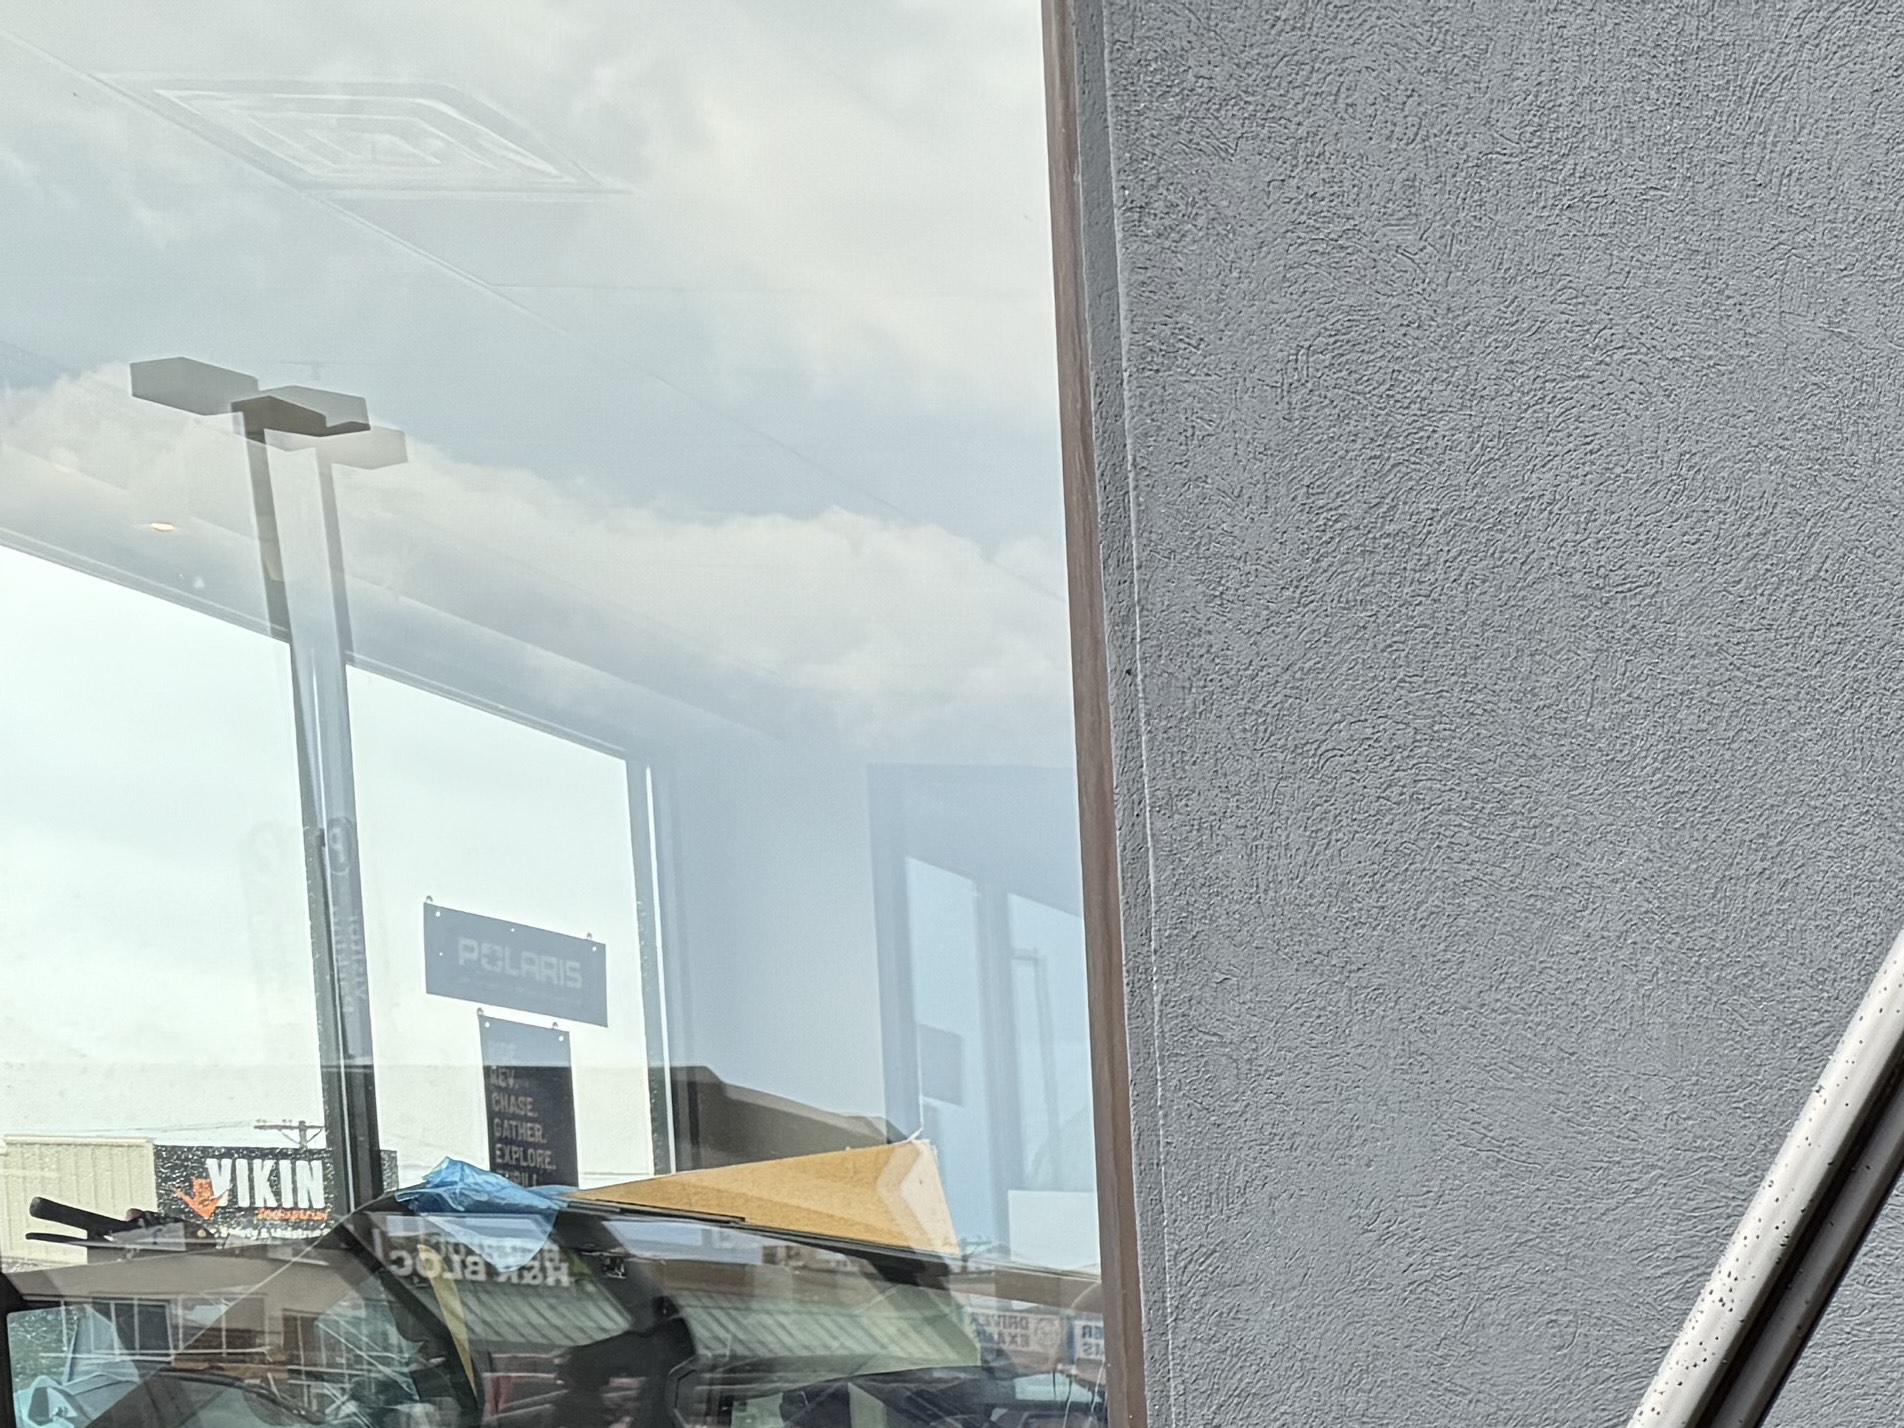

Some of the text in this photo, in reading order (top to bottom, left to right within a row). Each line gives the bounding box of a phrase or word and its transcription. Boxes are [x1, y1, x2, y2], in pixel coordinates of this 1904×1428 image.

[457, 936, 582, 989] POLARIS
[491, 1092, 538, 1118] CHASE.
[494, 1118, 547, 1143] GATHER.
[496, 1144, 556, 1170] EXPLORE.
[206, 1158, 326, 1208] VIKIN
